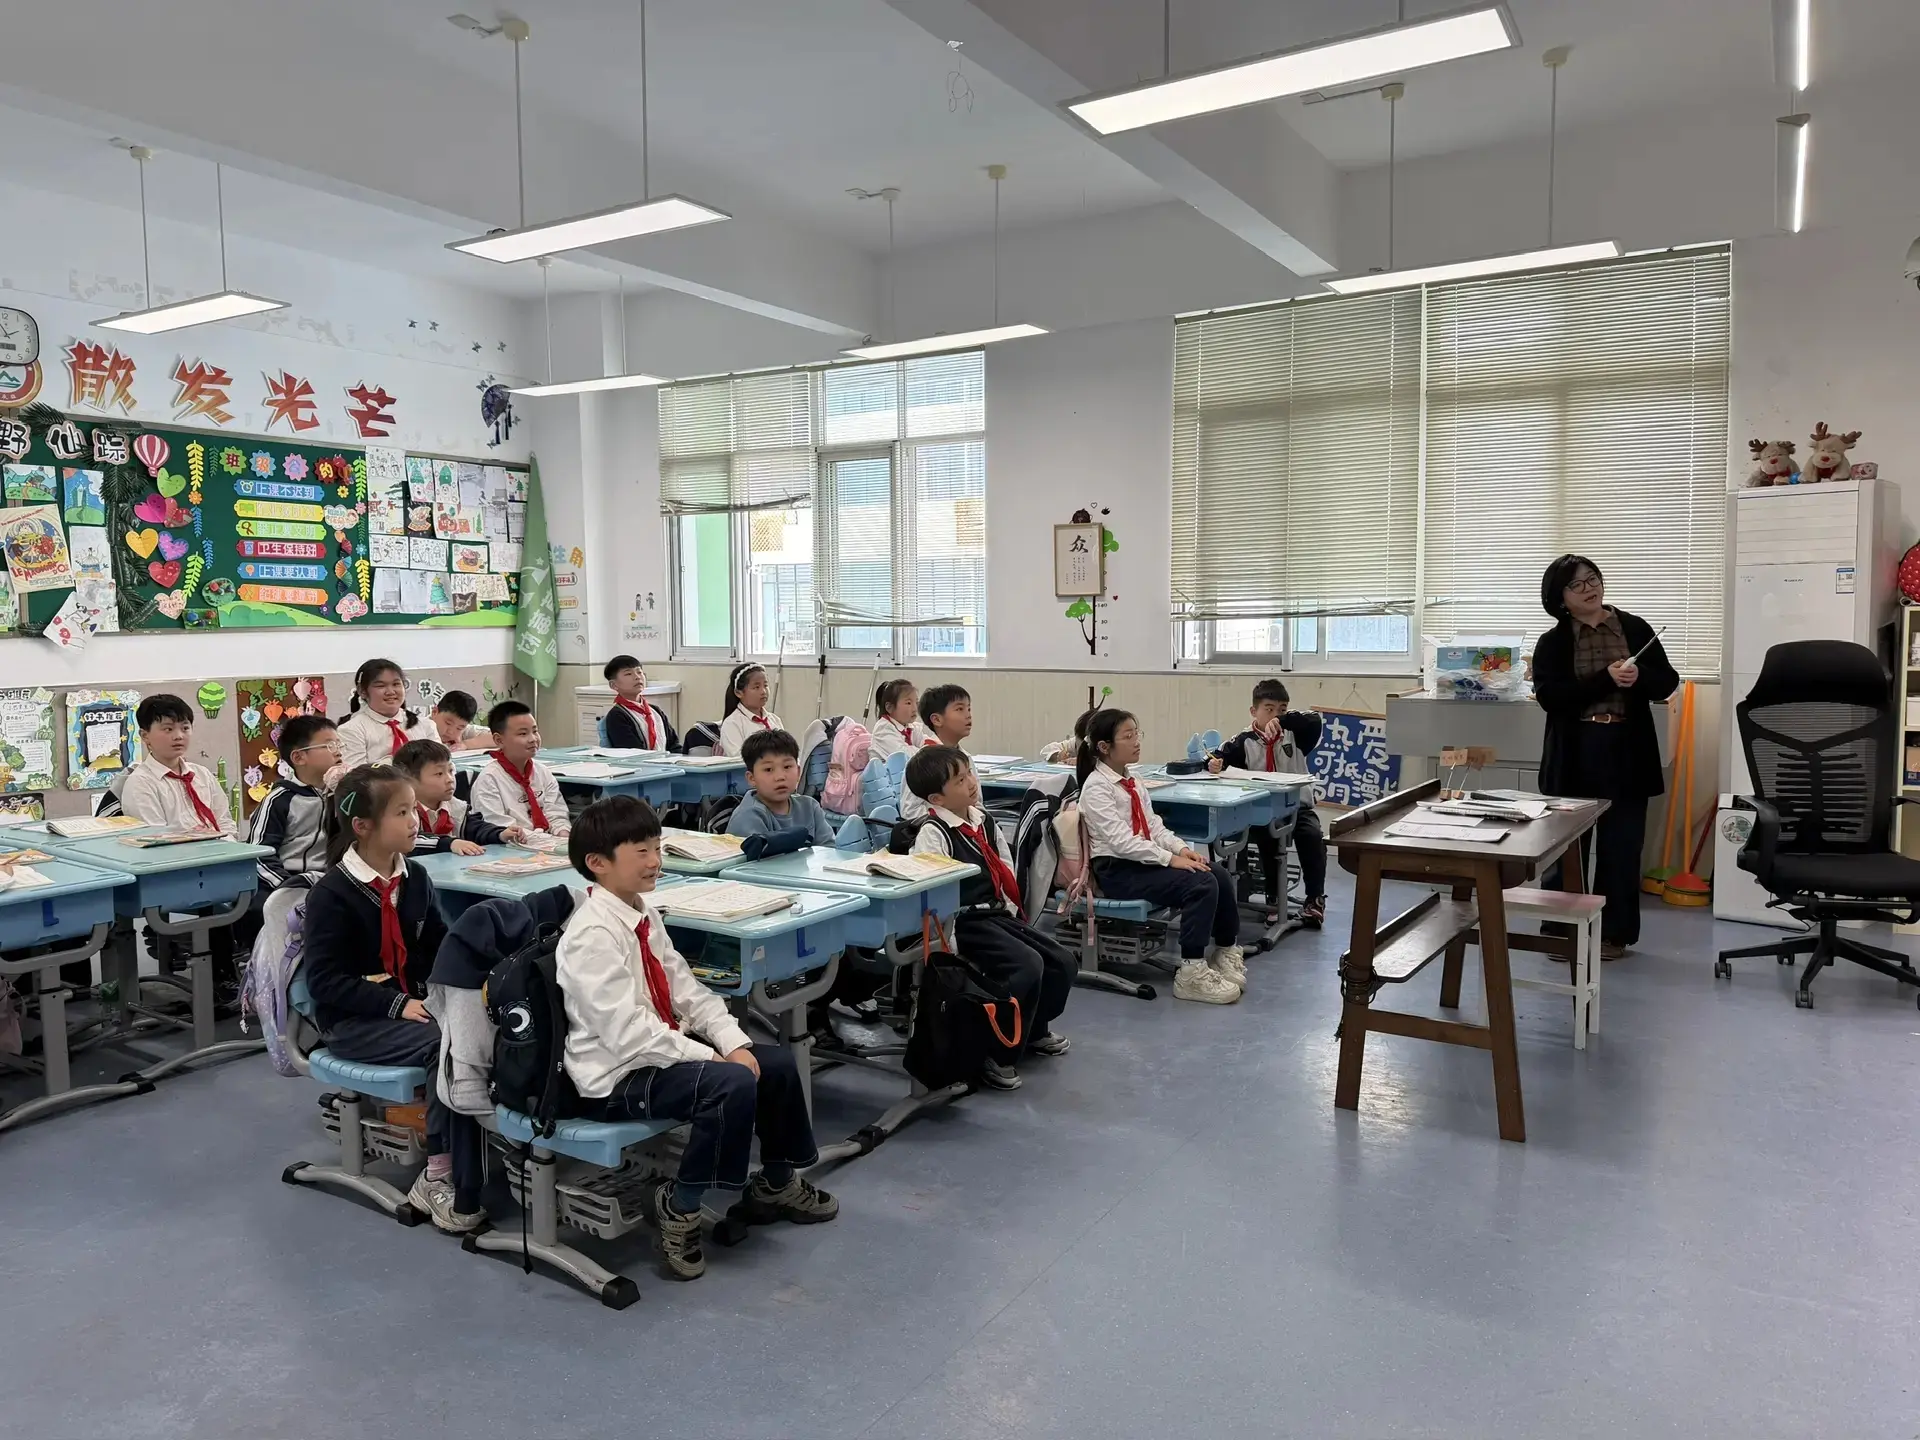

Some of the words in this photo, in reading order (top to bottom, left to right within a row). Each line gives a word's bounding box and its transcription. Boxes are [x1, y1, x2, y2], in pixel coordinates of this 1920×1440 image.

[1, 312, 9, 320] 12
[17, 353, 23, 361] 5
[68, 340, 397, 437] 散发光芒
[226, 453, 333, 478] 班级公约
[256, 483, 314, 498] 上课不迟到
[258, 542, 317, 557] 卫生保持好
[1069, 535, 1089, 553] 众
